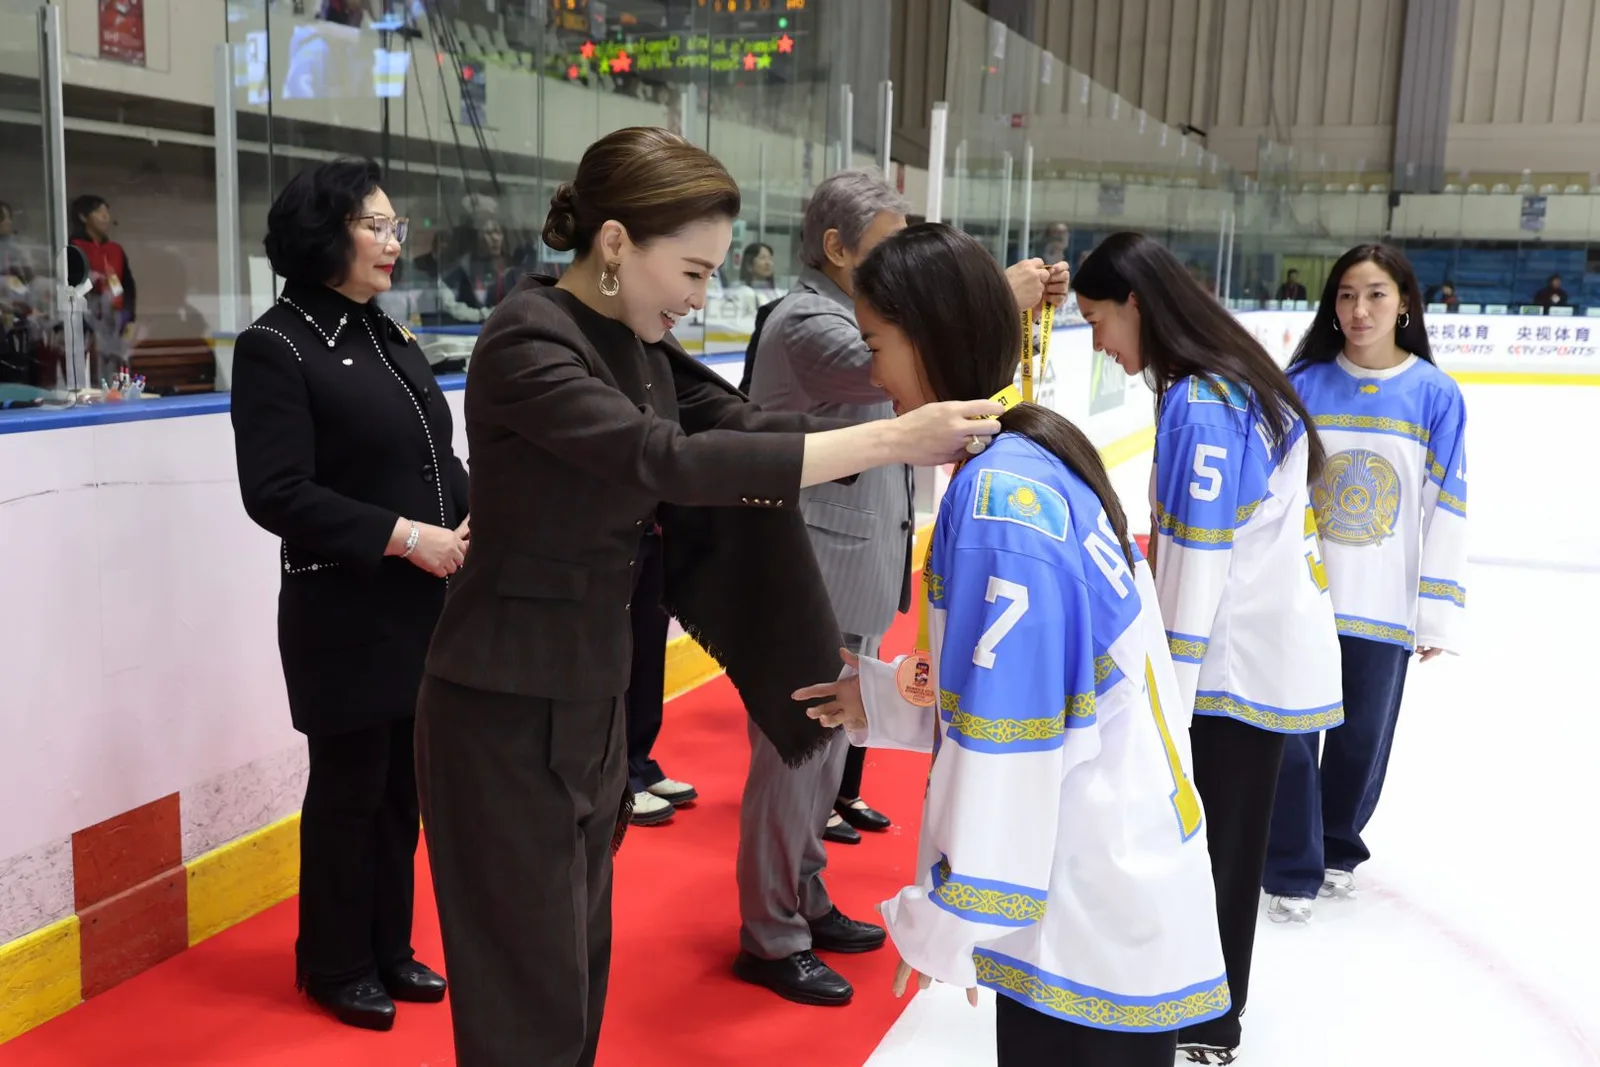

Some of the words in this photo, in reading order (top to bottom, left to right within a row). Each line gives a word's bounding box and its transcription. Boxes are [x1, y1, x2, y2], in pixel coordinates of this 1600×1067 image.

[1427, 324, 1489, 340] 央视体育
[1517, 326, 1590, 342] 央视体育
[1507, 345, 1537, 356] CCTV
[1537, 345, 1596, 357] SPORTS
[1189, 443, 1228, 502] 5
[972, 576, 1029, 669] 7
